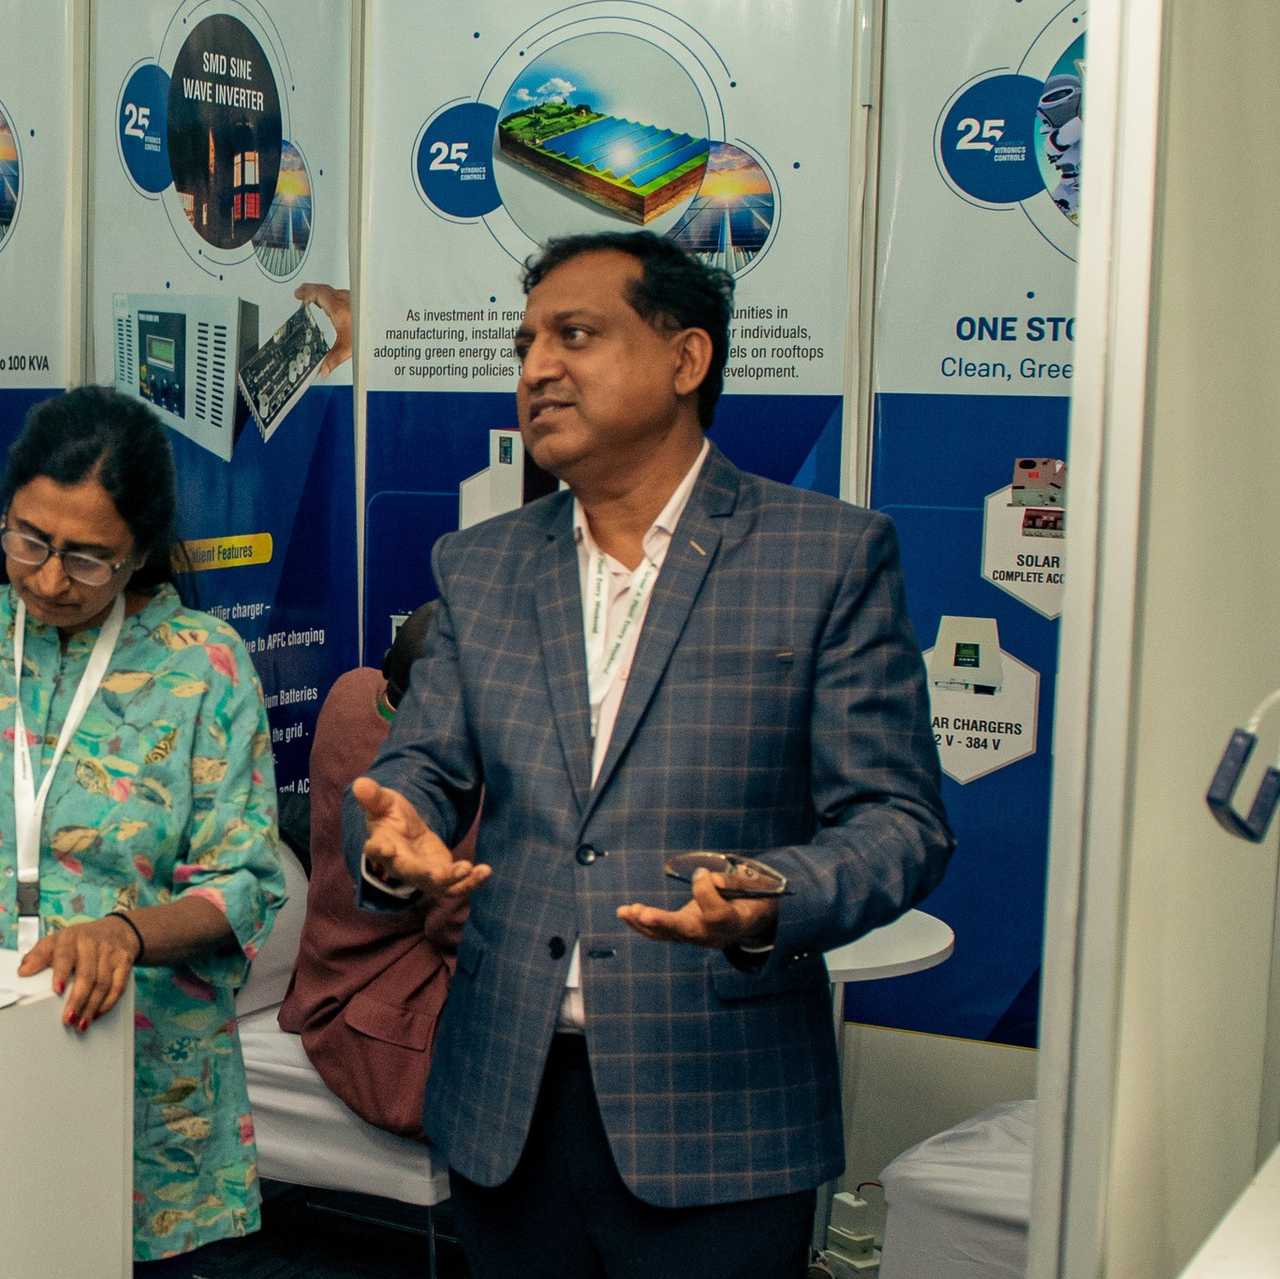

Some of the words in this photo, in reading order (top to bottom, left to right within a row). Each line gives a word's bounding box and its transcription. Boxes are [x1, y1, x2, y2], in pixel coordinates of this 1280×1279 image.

[203, 51, 226, 76] SMD
[230, 57, 252, 81] SINE
[183, 77, 213, 102] WAVE
[215, 84, 264, 112] INVERTER
[124, 103, 150, 140] 25
[956, 117, 1005, 152] 25
[429, 141, 469, 172] 25
[994, 146, 1027, 154] VITRONICS
[994, 154, 1026, 162] CONTROLS
[406, 309, 420, 322] As
[424, 309, 484, 322] investment
[488, 309, 498, 321] in
[776, 306, 788, 319] in
[385, 327, 468, 342] manufacturing,
[740, 325, 811, 341] individuals,
[956, 316, 1018, 341] ONE
[373, 345, 421, 361] adopting
[424, 347, 456, 360] green
[458, 347, 497, 361] energy
[729, 345, 747, 359] els
[751, 347, 767, 358] on
[771, 345, 824, 361] rooftops
[8, 355, 26, 371] 100
[29, 356, 49, 371] KVA
[394, 365, 406, 376] or
[409, 364, 468, 379] supporting
[472, 363, 515, 379] policies
[941, 357, 1012, 382] Clean,
[1020, 358, 1074, 379] Gree
[217, 545, 253, 562] Features
[1016, 554, 1060, 568] SOLAR
[992, 570, 1044, 583] COMPLETE
[257, 637, 266, 652] to
[267, 631, 286, 650] APFC
[287, 627, 325, 648] charging
[280, 686, 318, 705] Batteries
[272, 727, 284, 743] the
[286, 722, 303, 743] grid
[953, 718, 1022, 735] CHARGERS
[946, 734, 954, 746] V
[965, 736, 988, 749] 384
[992, 739, 1001, 751] V
